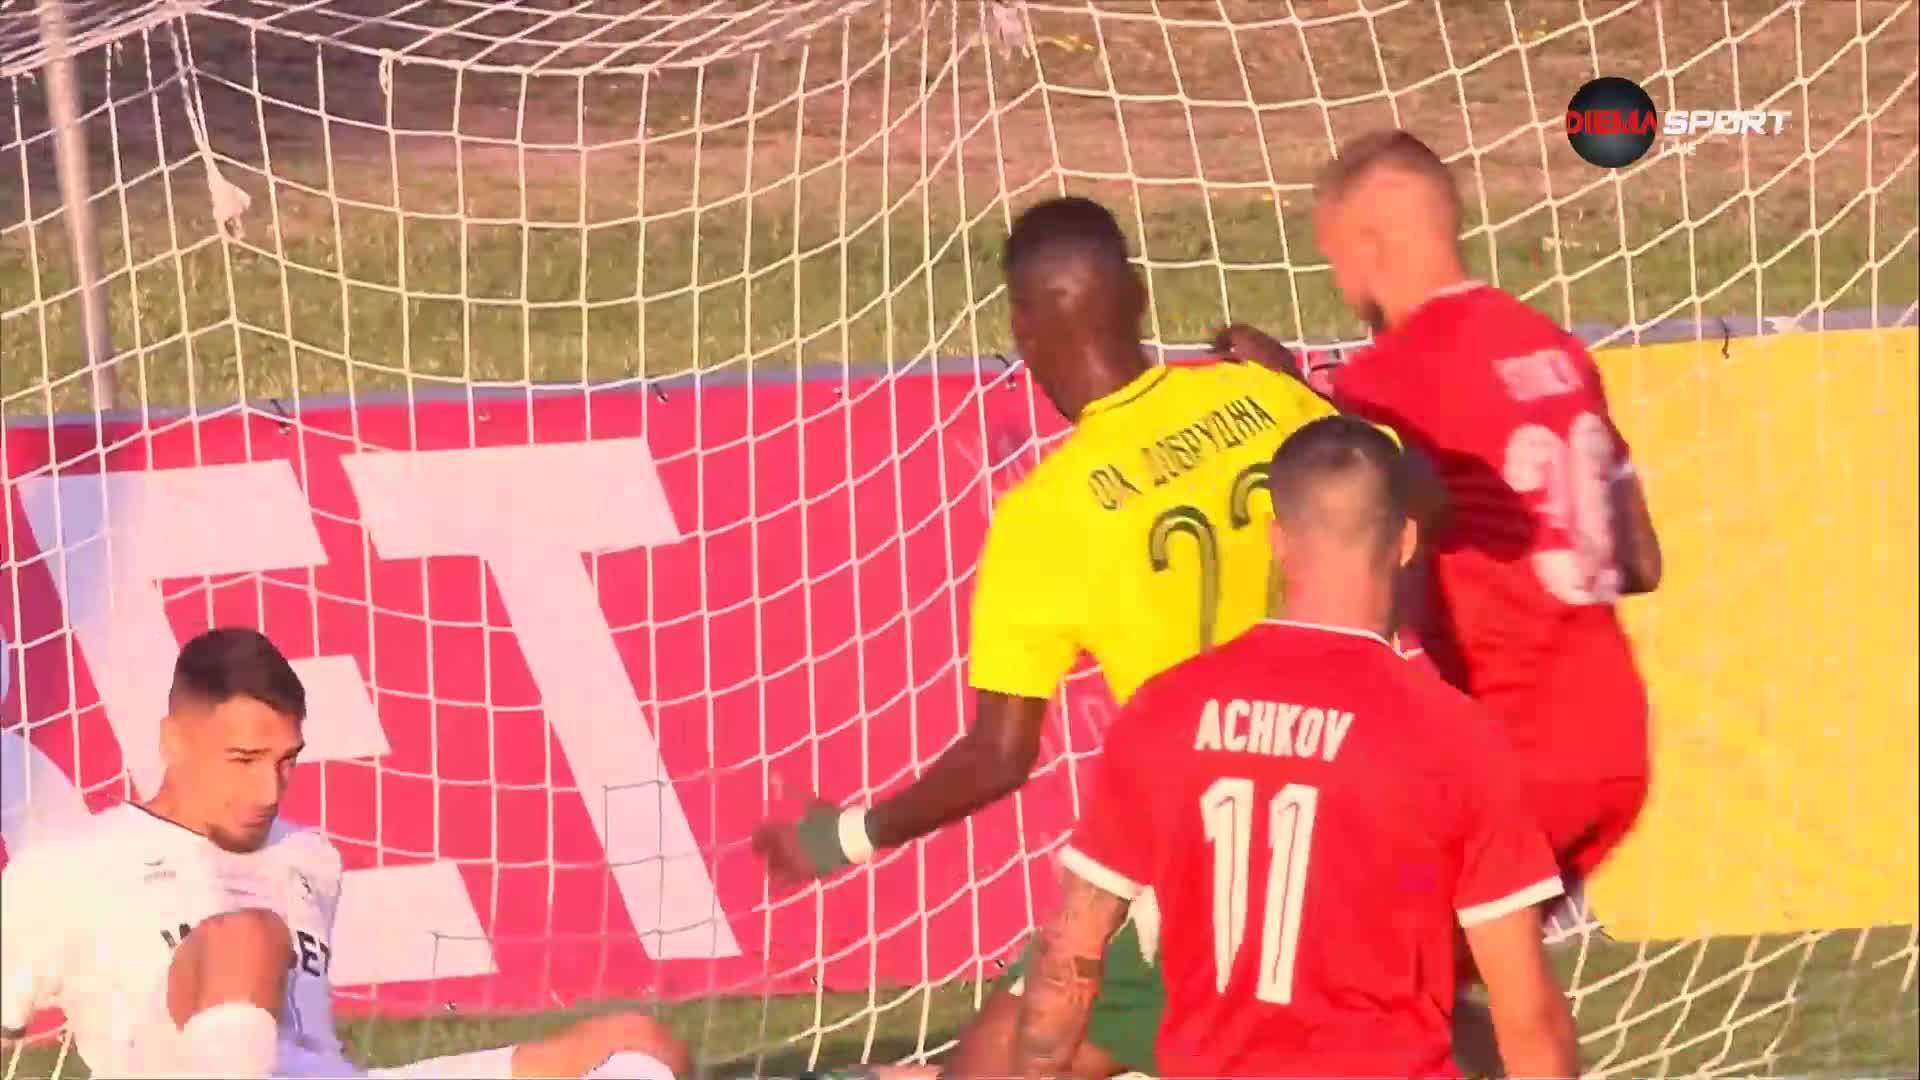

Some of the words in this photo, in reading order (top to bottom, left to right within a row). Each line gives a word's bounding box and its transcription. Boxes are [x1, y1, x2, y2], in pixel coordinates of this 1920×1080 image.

[0, 436, 741, 987] ET
[1194, 698, 1354, 762] ACHKOV
[1200, 776, 1318, 1006] 11
